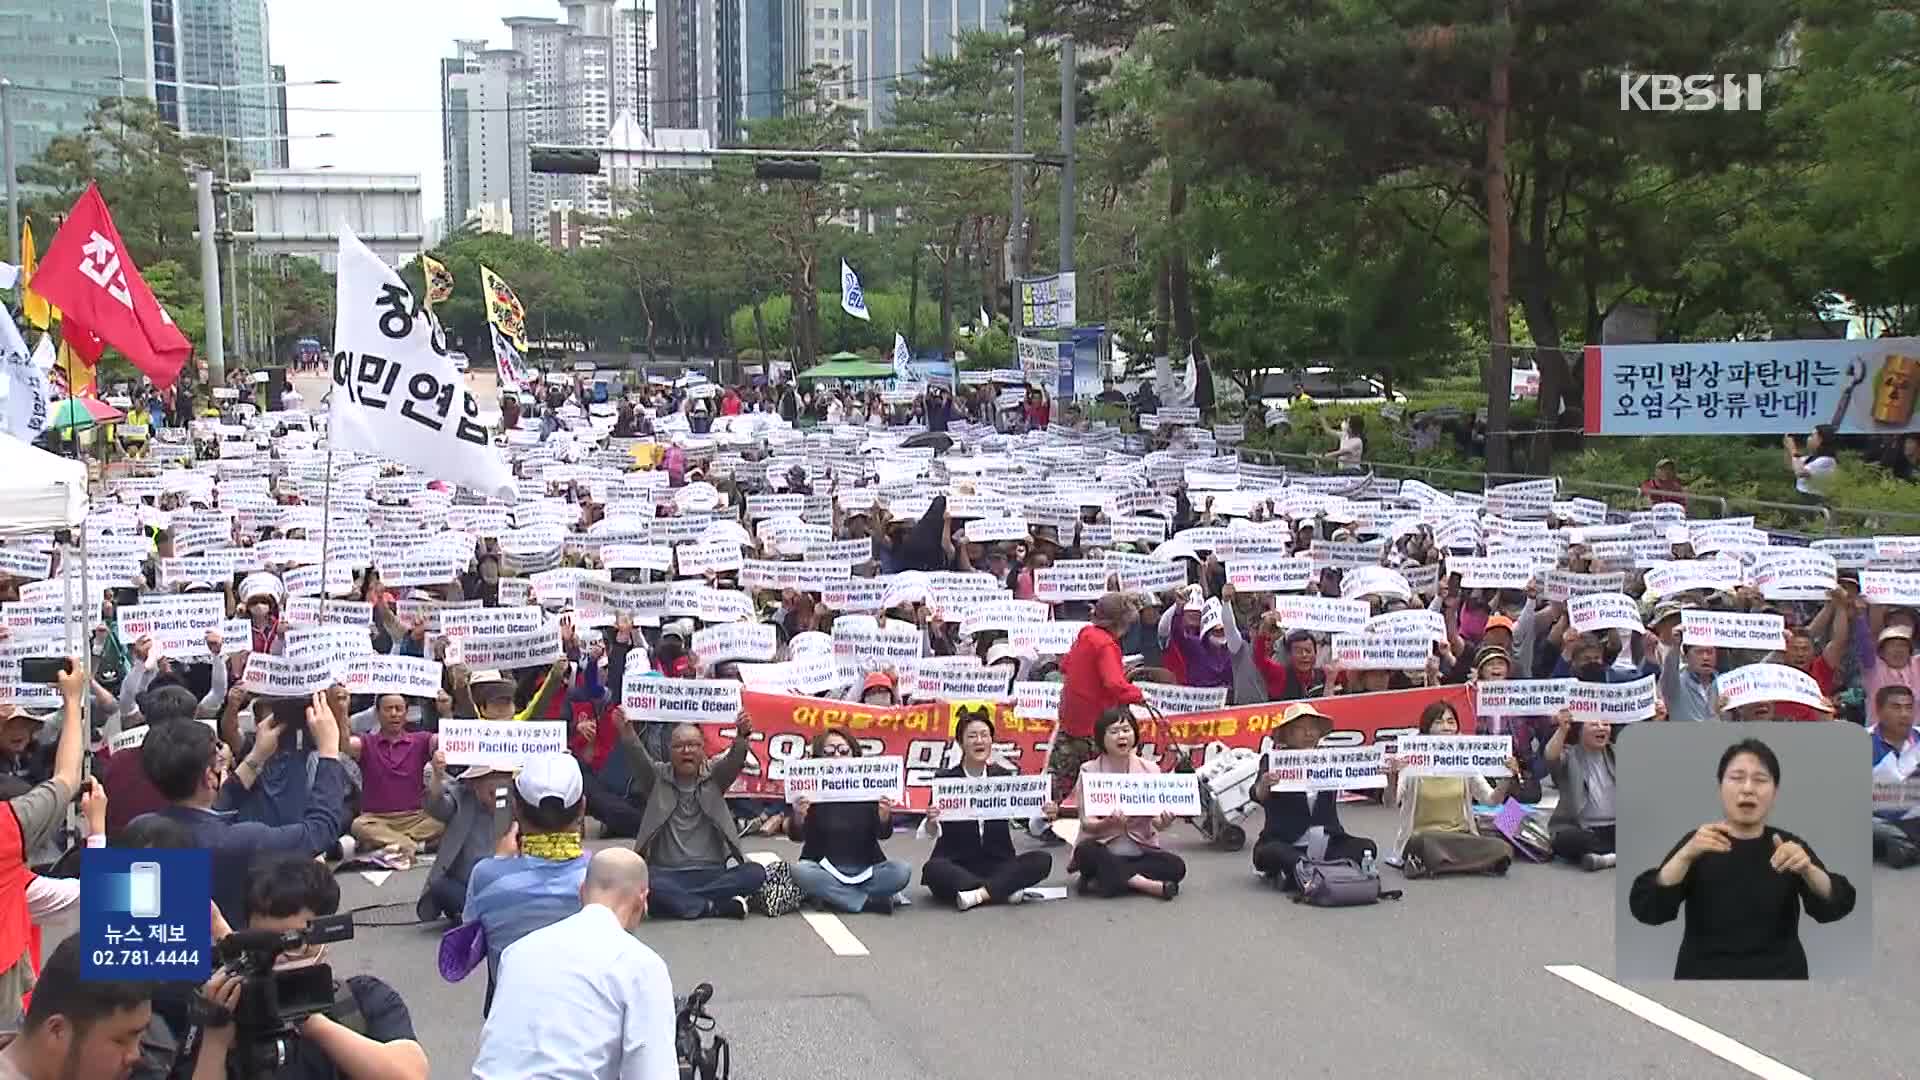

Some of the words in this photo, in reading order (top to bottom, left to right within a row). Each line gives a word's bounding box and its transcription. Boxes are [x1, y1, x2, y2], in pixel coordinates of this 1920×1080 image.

[1613, 362, 1664, 389] 국민
[1671, 361, 1723, 389] 밥상
[1728, 359, 1841, 388] 파탄내는
[1613, 391, 1692, 420] 오염수
[1697, 391, 1750, 419] 방류
[1755, 391, 1817, 419] 반대!
[1714, 627, 1746, 639] Pacific
[187, 638, 207, 648] Paci
[943, 681, 975, 693] Pacific
[626, 696, 656, 709] SOS!!
[659, 698, 699, 711] Pacific
[701, 699, 738, 712] Ocean!
[1543, 694, 1565, 706] Ocea
[479, 741, 518, 753] Pacific
[521, 742, 560, 753] Ocean!
[1433, 754, 1470, 766] Pacific
[1306, 767, 1343, 779] Pacific
[790, 779, 818, 791] SOS!!
[821, 777, 860, 790] Pacific
[862, 776, 898, 789] Ocean!
[969, 797, 1007, 808] Pacific
[1010, 794, 1046, 806] Ocean!
[1119, 793, 1156, 804] Pacific
[1158, 792, 1194, 804] Ocean!
